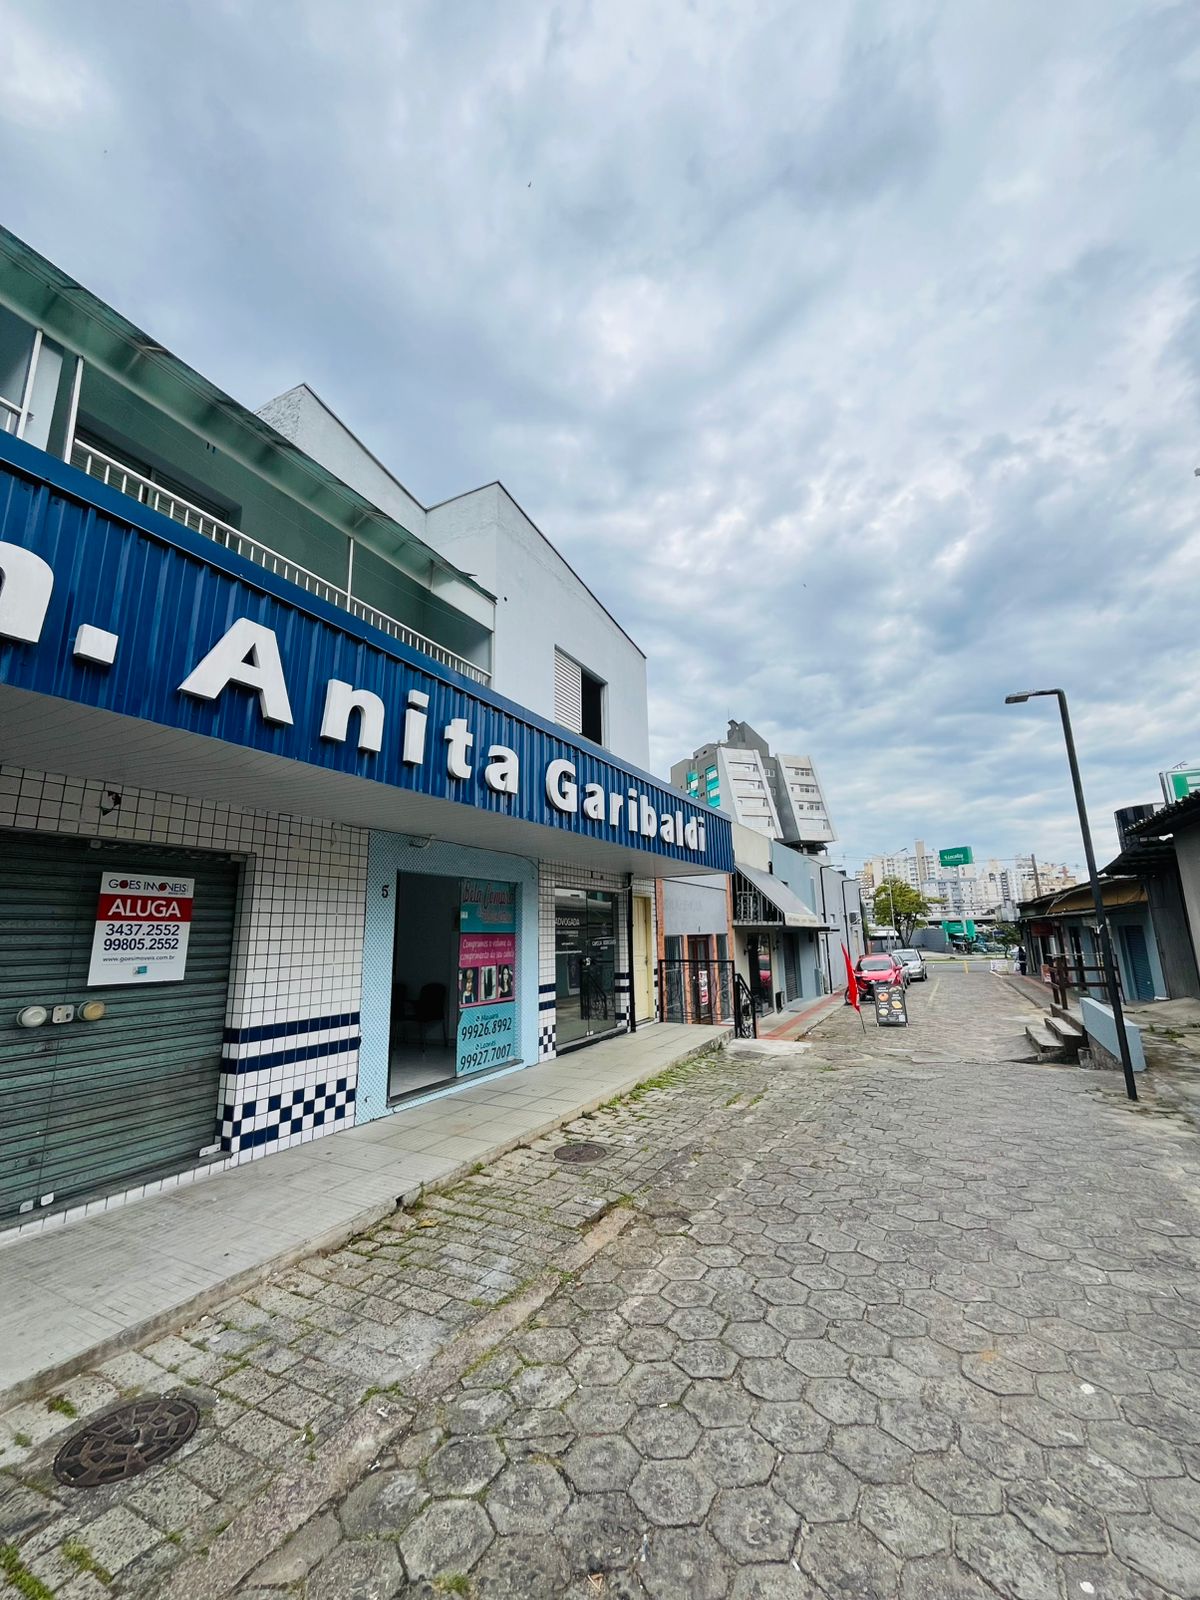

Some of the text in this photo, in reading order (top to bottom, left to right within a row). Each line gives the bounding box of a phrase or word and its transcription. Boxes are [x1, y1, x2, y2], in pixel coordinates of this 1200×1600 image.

[177, 617, 518, 794] Anita
[546, 758, 706, 852] Garibaldi
[381, 884, 390, 899] 5
[107, 898, 181, 918] ALUGA
[105, 923, 180, 936] 3437.2552
[555, 916, 580, 927] ADVOGADA
[103, 938, 179, 951] 99805.2552
[461, 1017, 512, 1041] 99926.8992
[460, 1043, 512, 1070] 99927.7007
